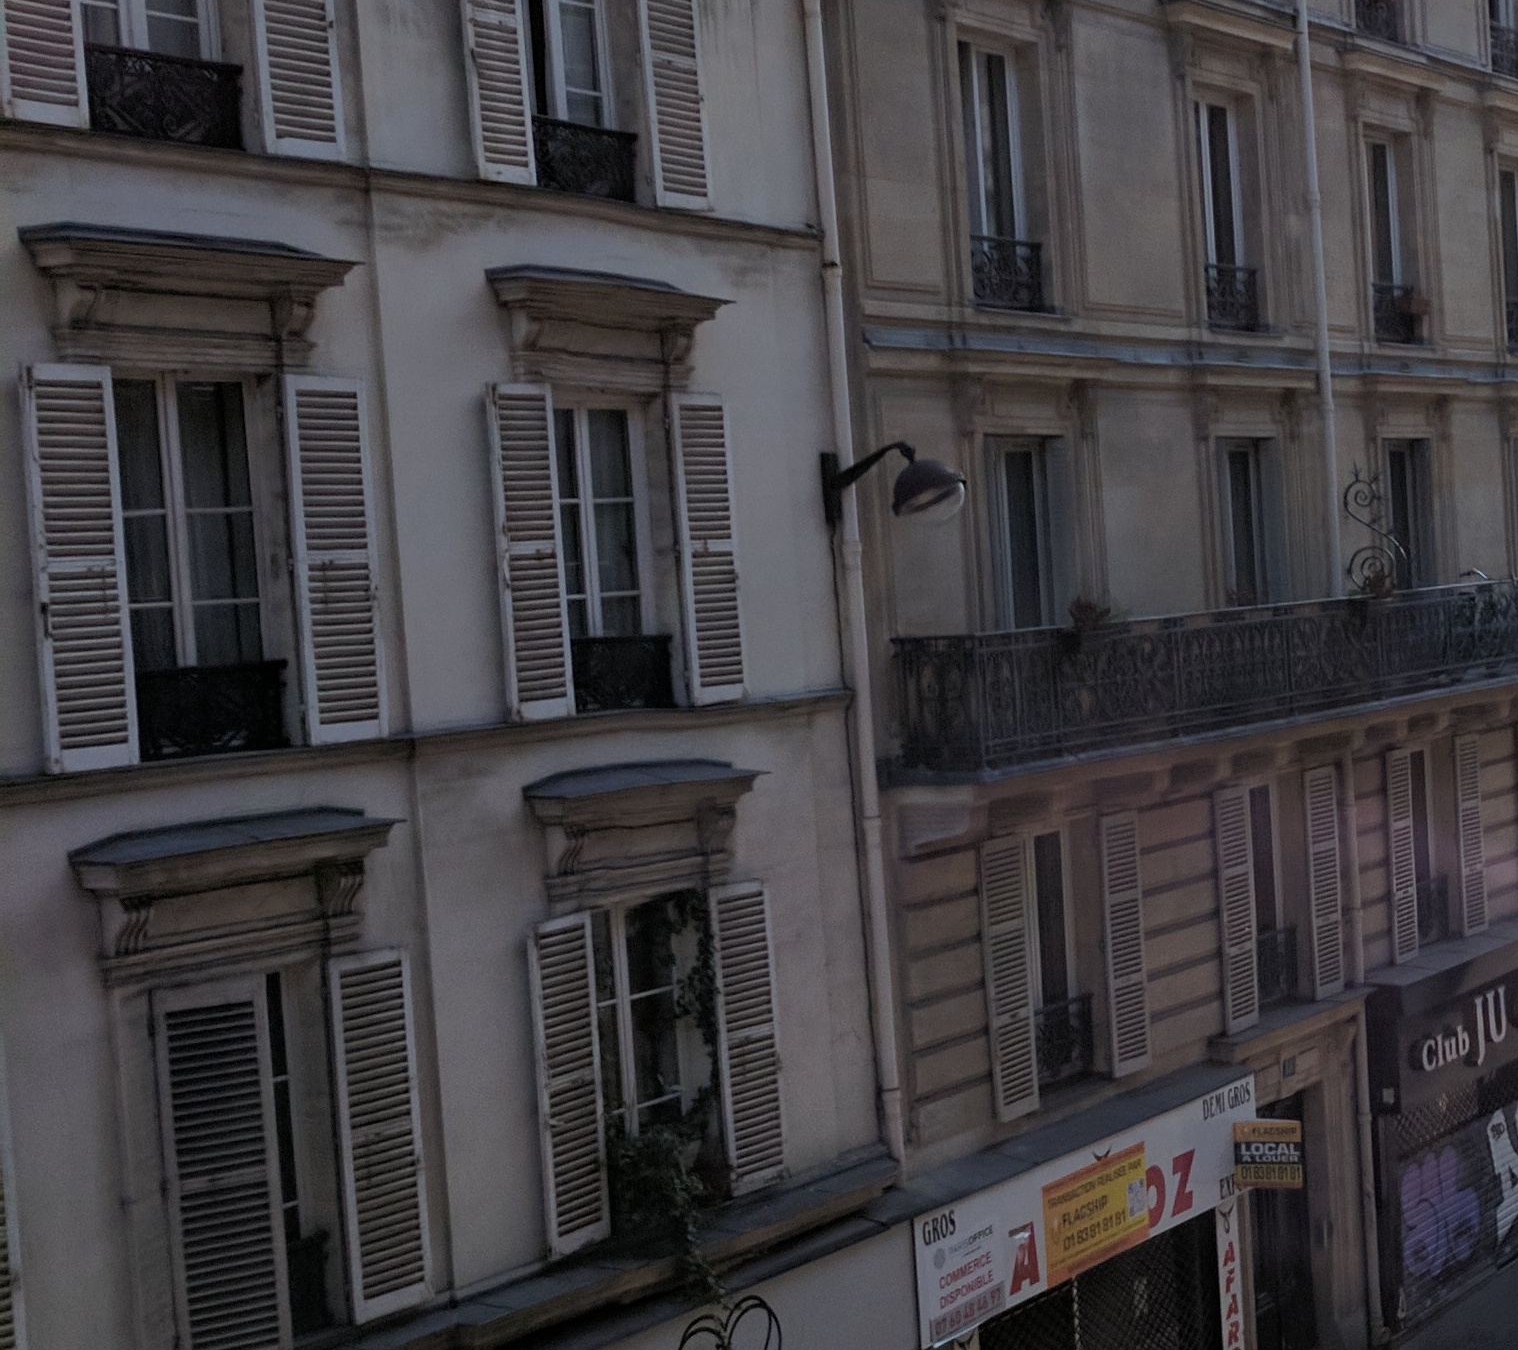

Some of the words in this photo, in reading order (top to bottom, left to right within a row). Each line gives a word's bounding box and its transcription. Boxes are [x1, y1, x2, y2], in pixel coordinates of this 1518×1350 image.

[1421, 1027, 1470, 1073] Club
[1472, 986, 1508, 1067] JU
[1203, 1091, 1227, 1120] DEMI
[1227, 1081, 1251, 1110] GROS
[1241, 1142, 1300, 1155] LOCAL
[1251, 1126, 1297, 1136] FLAGSHIP
[1255, 1154, 1298, 1162] LOUER
[922, 1209, 956, 1246] GROS
[1062, 1194, 1108, 1228] FLAGSHIP
[939, 1251, 993, 1289] COMMERCE
[940, 1270, 994, 1309] DISPONIBLE
